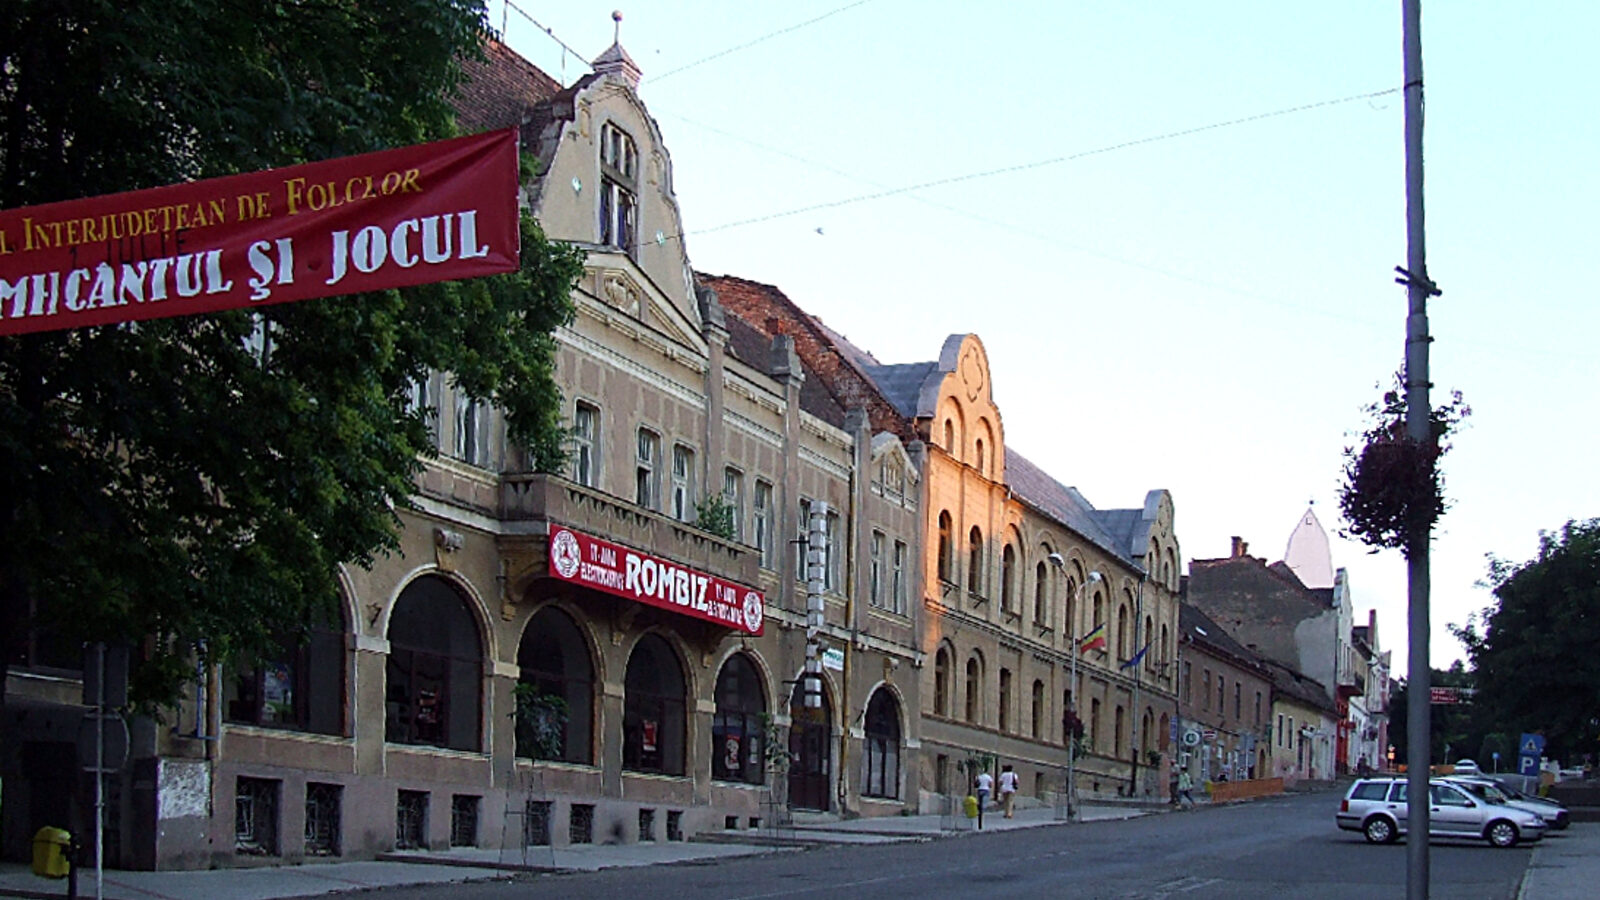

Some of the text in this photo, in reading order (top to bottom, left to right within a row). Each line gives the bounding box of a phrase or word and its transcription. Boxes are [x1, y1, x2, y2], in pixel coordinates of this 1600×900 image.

[238, 192, 272, 221] DE
[284, 168, 423, 215] FOLCLOR
[324, 209, 490, 286] JOCUL
[625, 552, 708, 612] ROMBIZ
[1521, 756, 1535, 774] P
